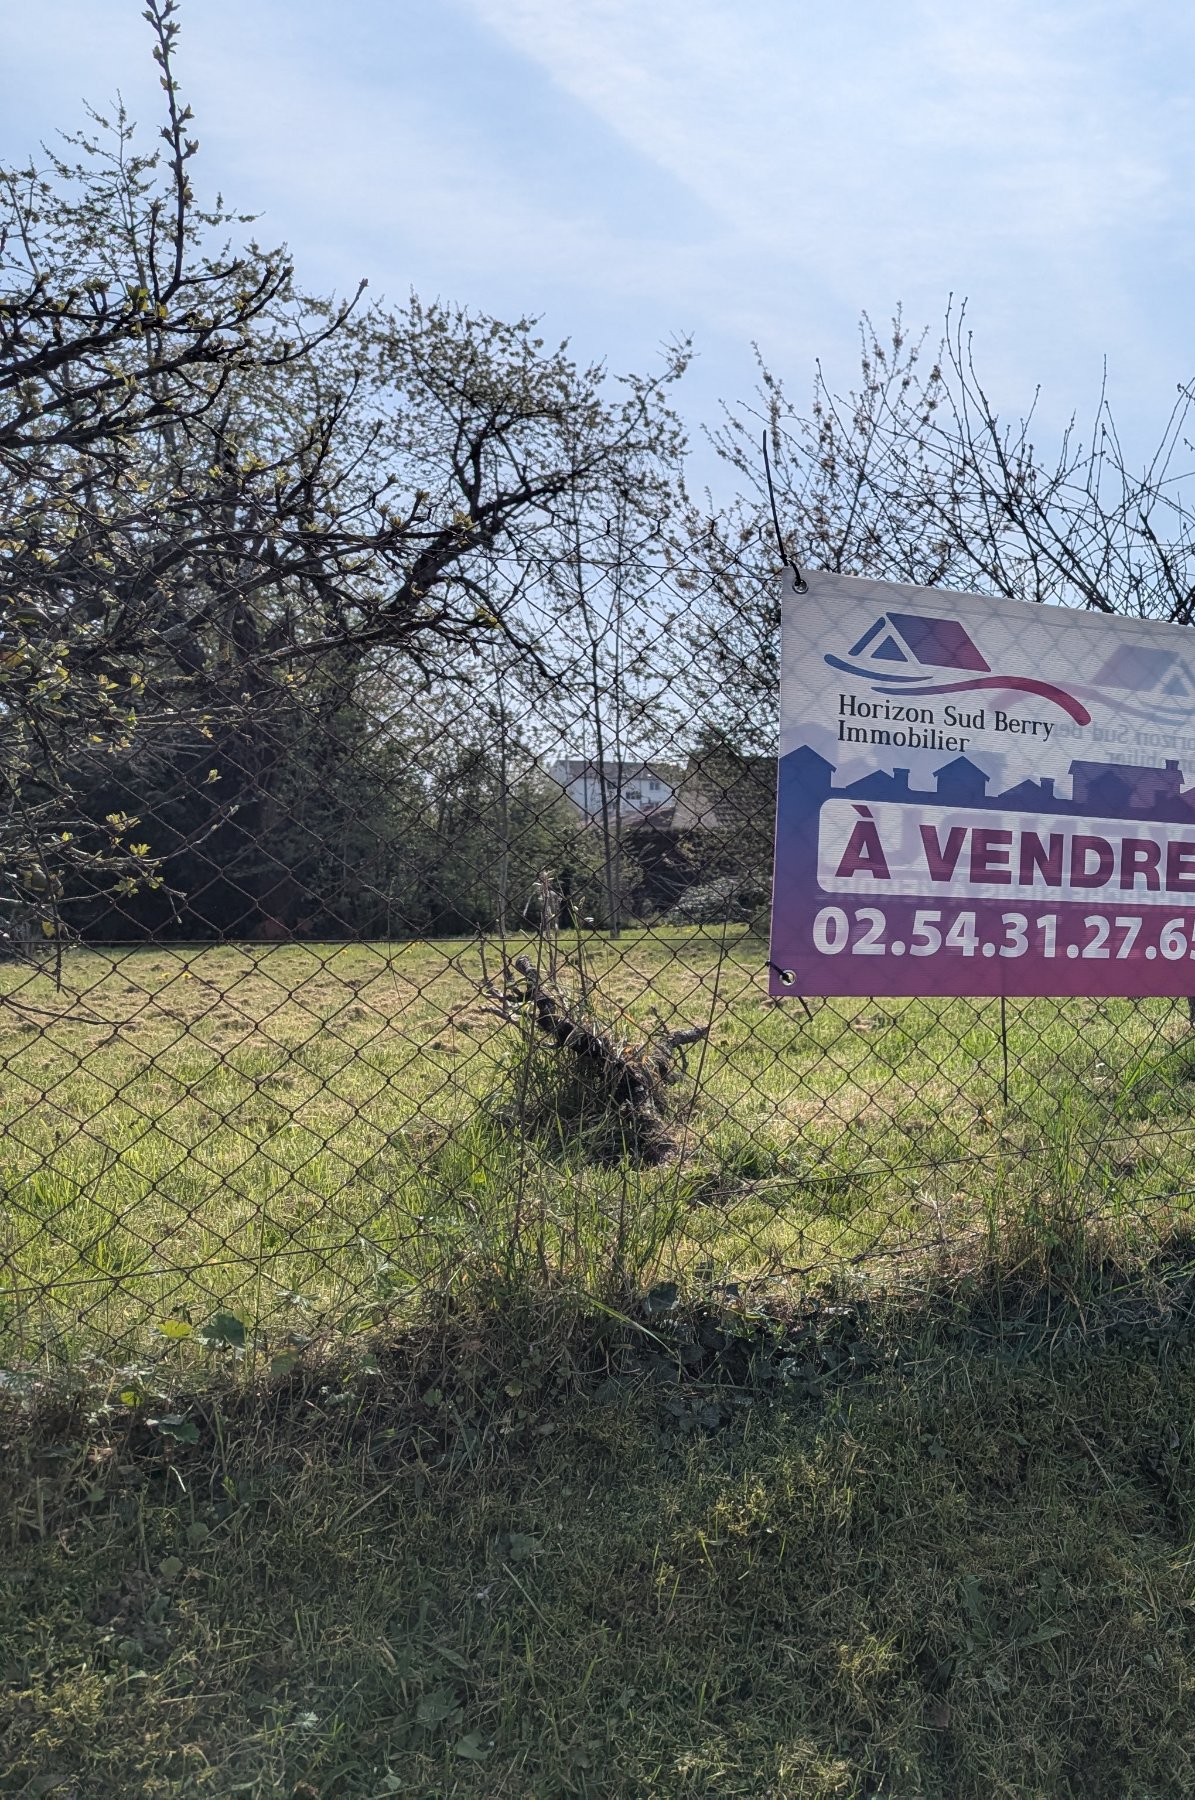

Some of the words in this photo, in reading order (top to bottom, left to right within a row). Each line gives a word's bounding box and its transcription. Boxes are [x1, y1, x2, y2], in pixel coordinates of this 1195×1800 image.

[837, 719, 971, 752] Immobilier
[838, 693, 935, 725] Horizon
[943, 705, 986, 730] Sud
[994, 710, 1055, 742] Berry
[834, 804, 892, 879] À
